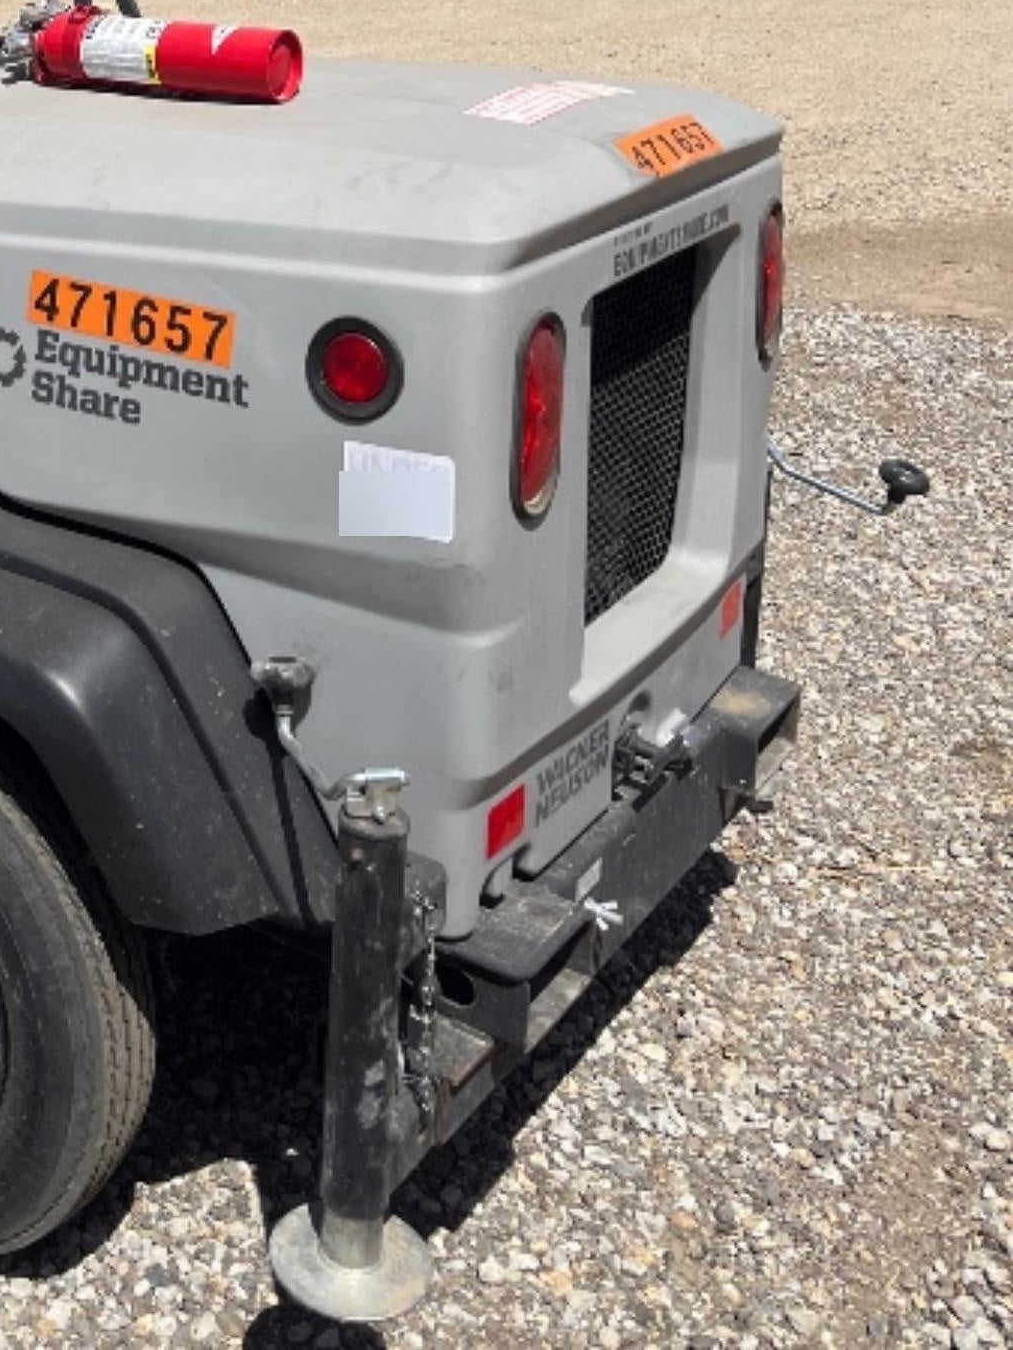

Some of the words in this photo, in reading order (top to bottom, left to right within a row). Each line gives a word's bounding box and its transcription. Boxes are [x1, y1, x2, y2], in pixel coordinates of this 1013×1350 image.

[631, 122, 715, 170] 471657
[34, 278, 228, 361] 471657
[31, 369, 141, 425] Share
[34, 329, 249, 408] Equipment
